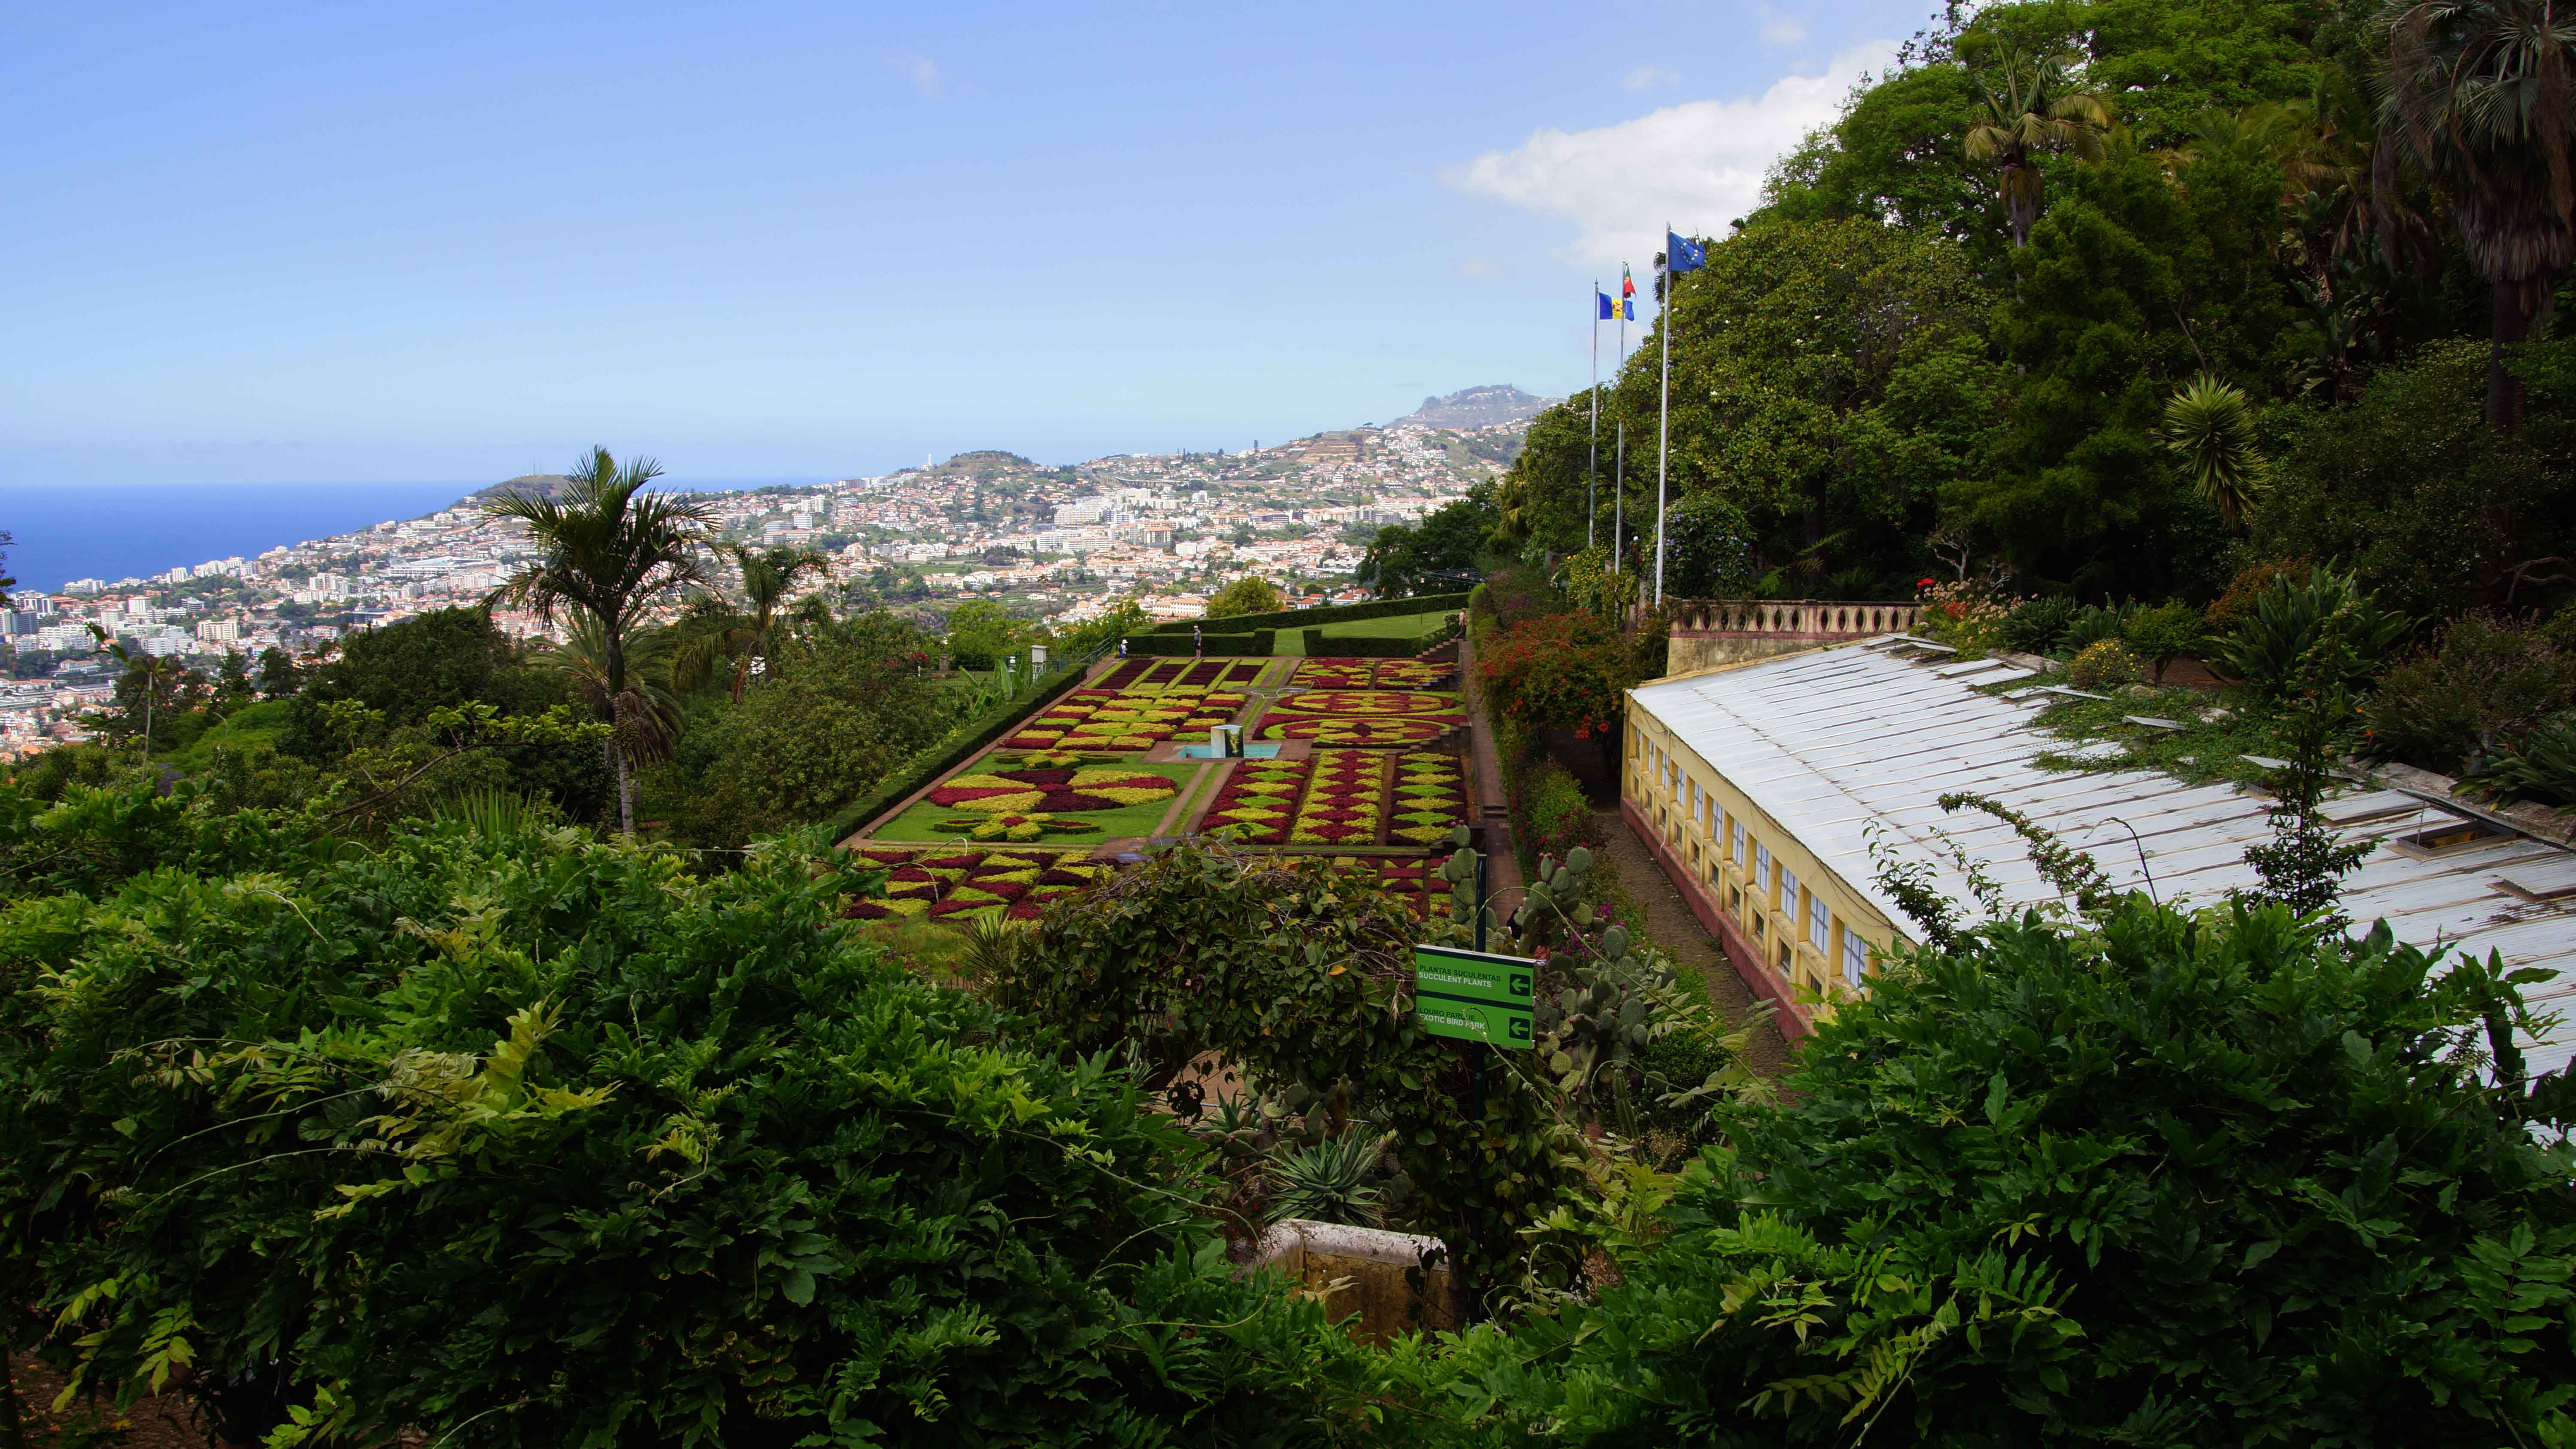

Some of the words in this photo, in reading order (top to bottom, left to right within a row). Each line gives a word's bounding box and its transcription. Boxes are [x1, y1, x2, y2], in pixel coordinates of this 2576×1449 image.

[1419, 965, 1452, 975] PLANTAS
[1453, 970, 1501, 982] SUCULENTAS
[1419, 972, 1461, 983] SUCCULENT
[1463, 978, 1491, 987] PLANTS
[1419, 1008, 1444, 1016] LOURO
[1446, 1018, 1464, 1026] BIRD
[1465, 1021, 1485, 1030] PARK
